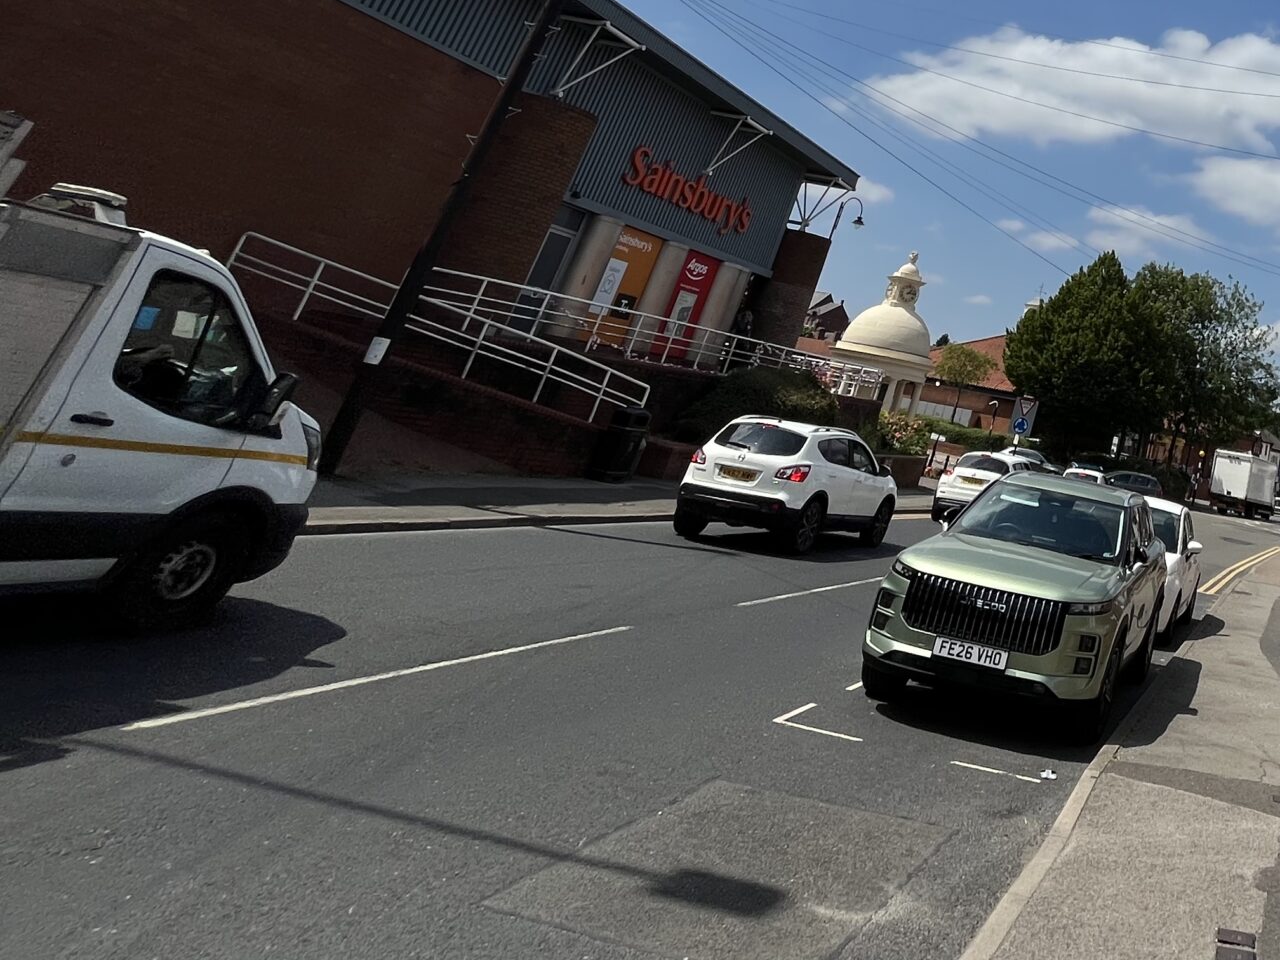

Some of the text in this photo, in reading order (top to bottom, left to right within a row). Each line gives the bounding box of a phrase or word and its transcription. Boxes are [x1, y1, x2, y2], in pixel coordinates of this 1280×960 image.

[622, 146, 751, 236] Sainsbury's
[619, 232, 653, 252] Sainsbury's
[687, 259, 708, 275] Argos
[939, 640, 1002, 666] FE26 VHO
